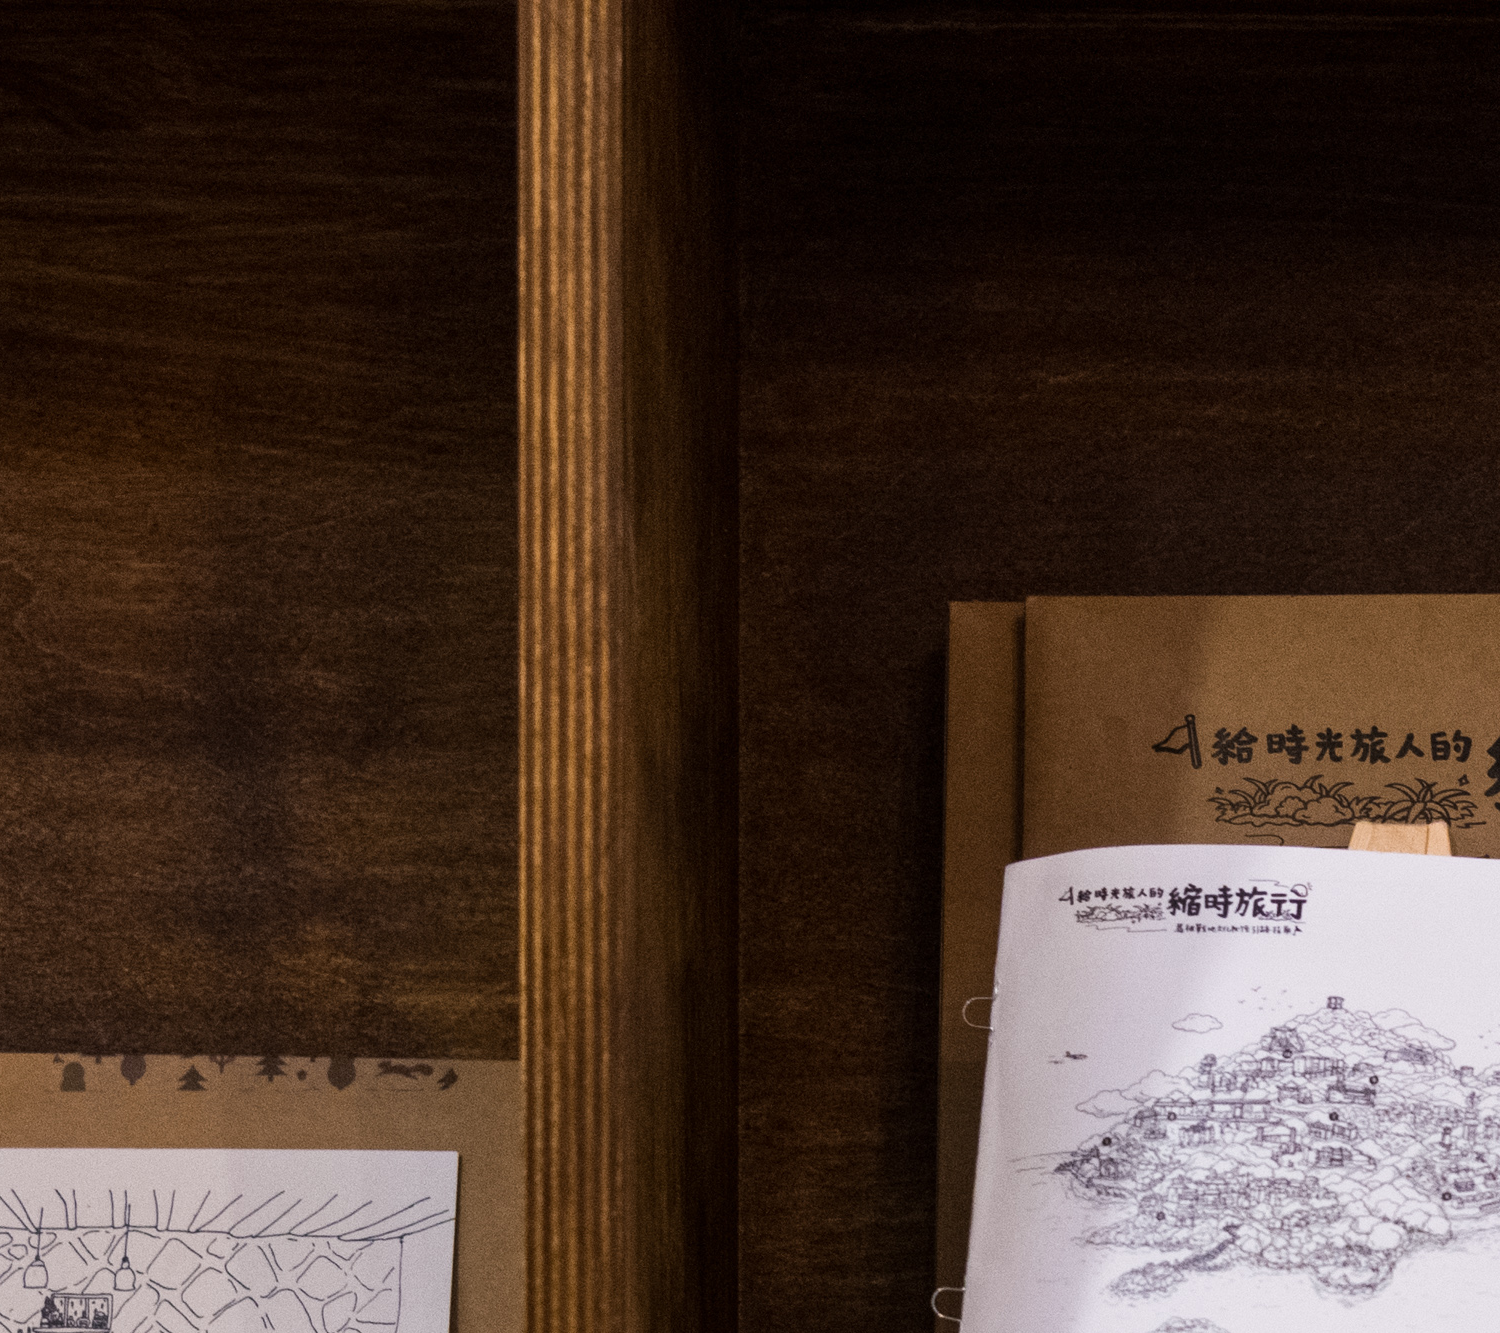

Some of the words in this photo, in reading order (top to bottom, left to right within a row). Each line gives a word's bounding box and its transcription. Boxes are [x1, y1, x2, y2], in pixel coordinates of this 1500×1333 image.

[1211, 725, 1472, 767] 給時光旅人的
[1167, 883, 1308, 921] 縮時旅行
